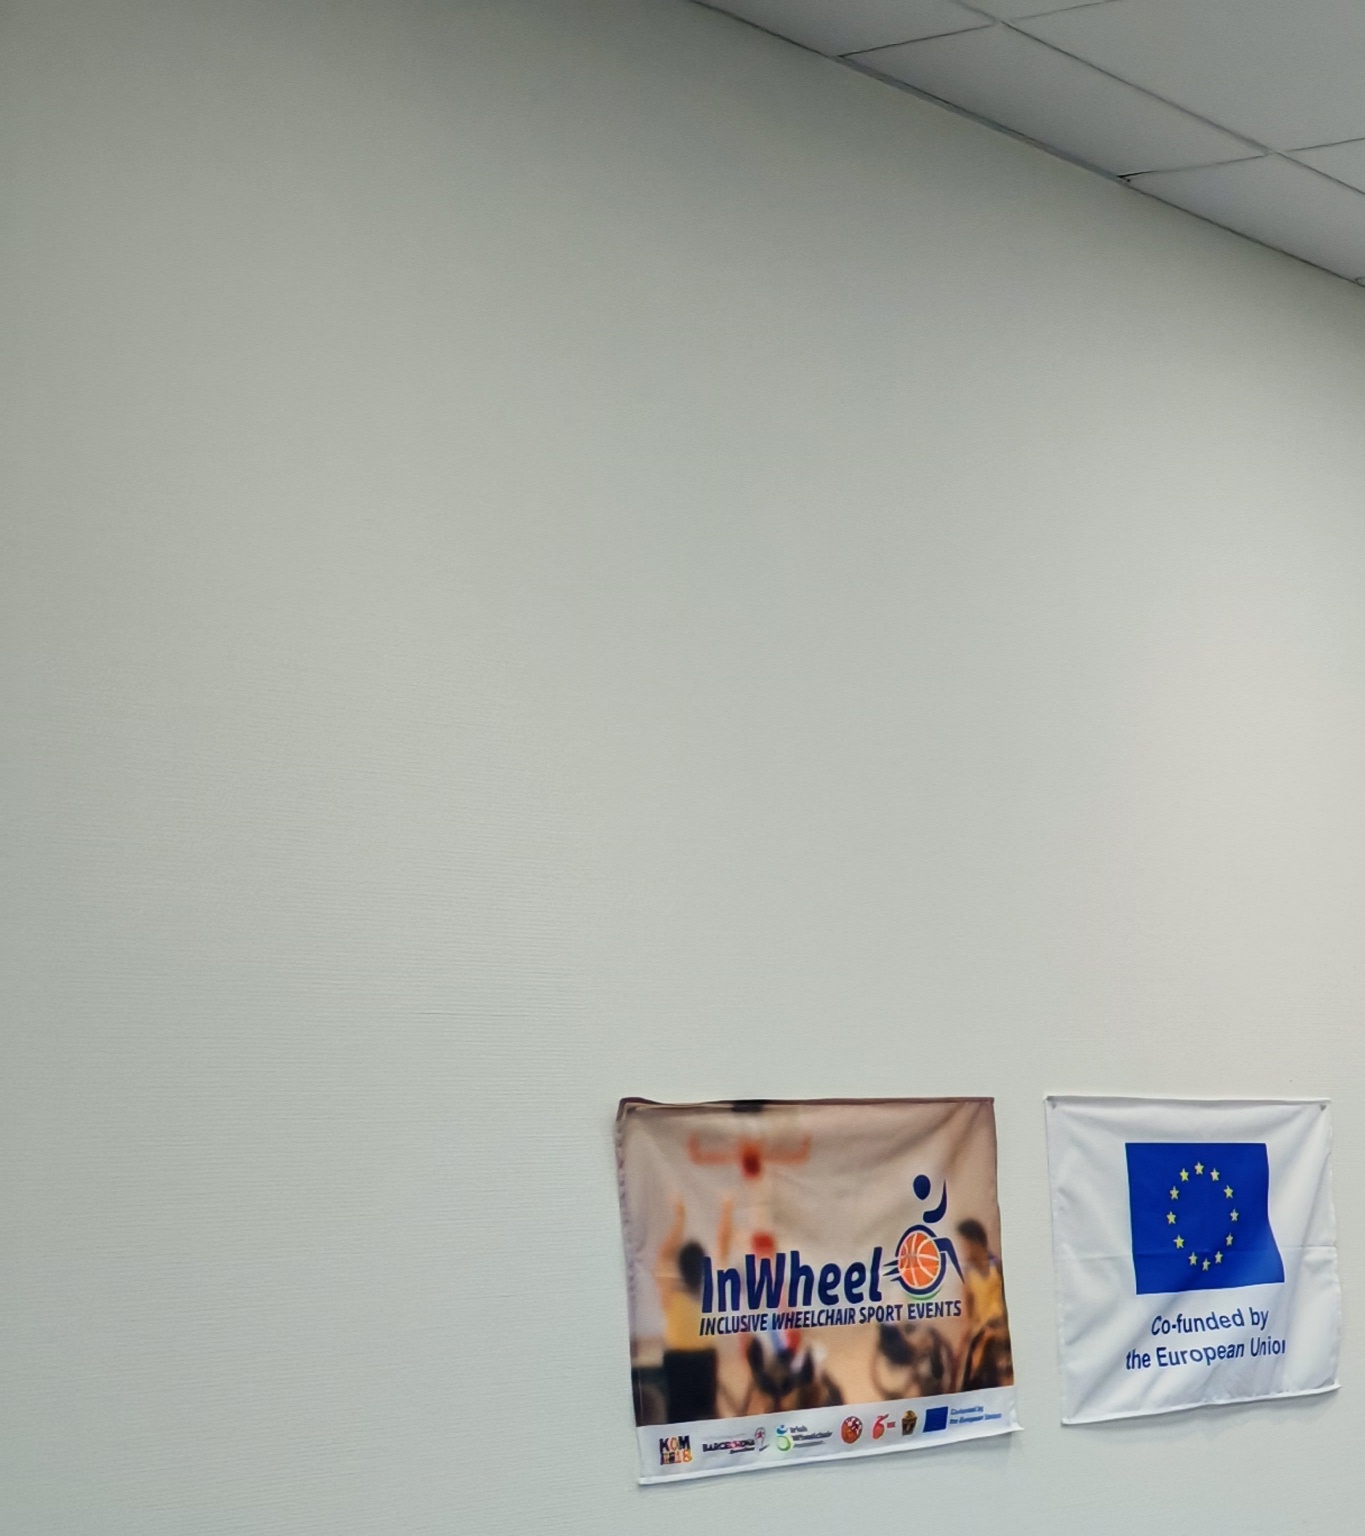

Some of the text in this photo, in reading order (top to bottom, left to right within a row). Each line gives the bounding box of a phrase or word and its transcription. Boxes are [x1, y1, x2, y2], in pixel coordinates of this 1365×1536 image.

[702, 1247, 882, 1313] InWheel
[699, 1300, 961, 1336] INCLUSIVE WHEELCHAIR SPORT EVENTS
[1151, 1307, 1269, 1336] Co-funded by
[1126, 1349, 1151, 1370] the
[1156, 1343, 1245, 1366] European
[659, 1435, 691, 1451] KOM
